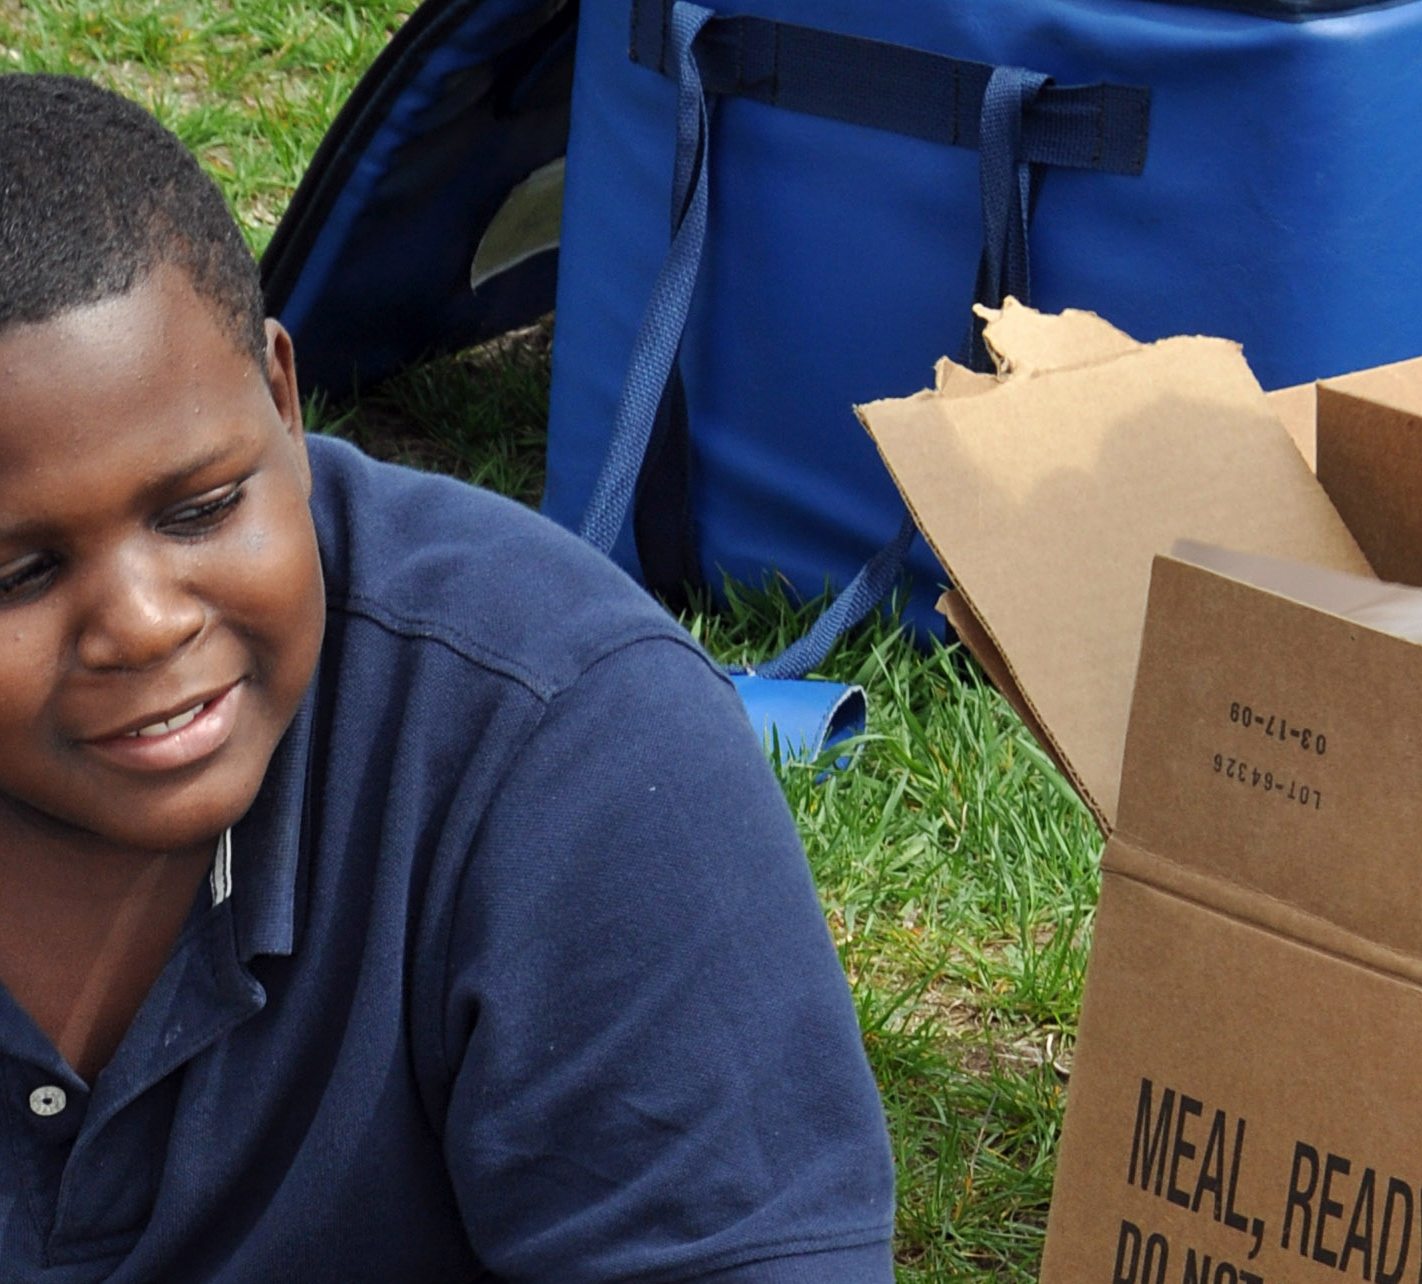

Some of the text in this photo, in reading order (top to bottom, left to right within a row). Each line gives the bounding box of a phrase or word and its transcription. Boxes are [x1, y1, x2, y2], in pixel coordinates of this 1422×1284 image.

[1230, 702, 1327, 756] 03-17-09
[1213, 754, 1322, 810] LOT-64326
[1127, 1076, 1265, 1260] MEAL,
